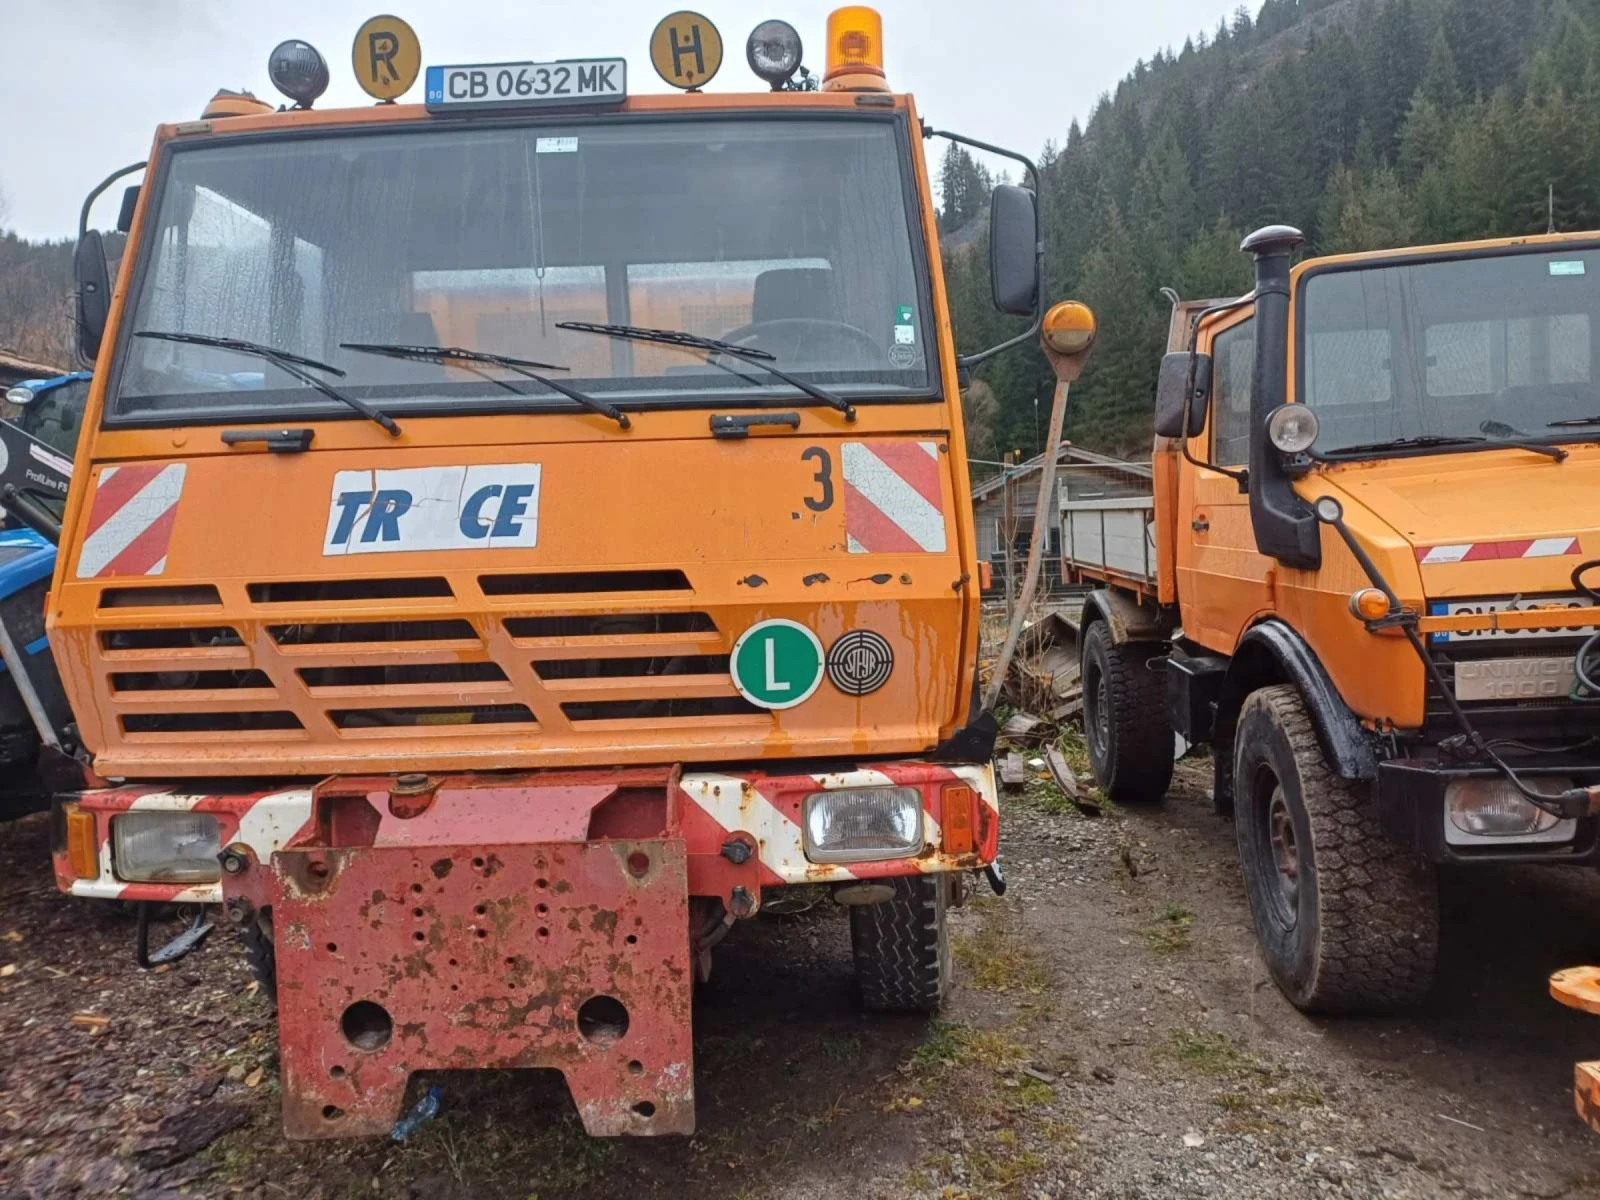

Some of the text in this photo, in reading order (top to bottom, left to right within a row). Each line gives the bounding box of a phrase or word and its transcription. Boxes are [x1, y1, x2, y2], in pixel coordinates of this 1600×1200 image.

[368, 31, 400, 82] R
[670, 24, 706, 77] H
[429, 91, 442, 99] BG
[449, 65, 617, 98] CB 0632 MK
[801, 446, 834, 512] 3
[765, 638, 791, 691] L
[845, 648, 876, 679] STEYR
[1485, 680, 1559, 698] 1000
